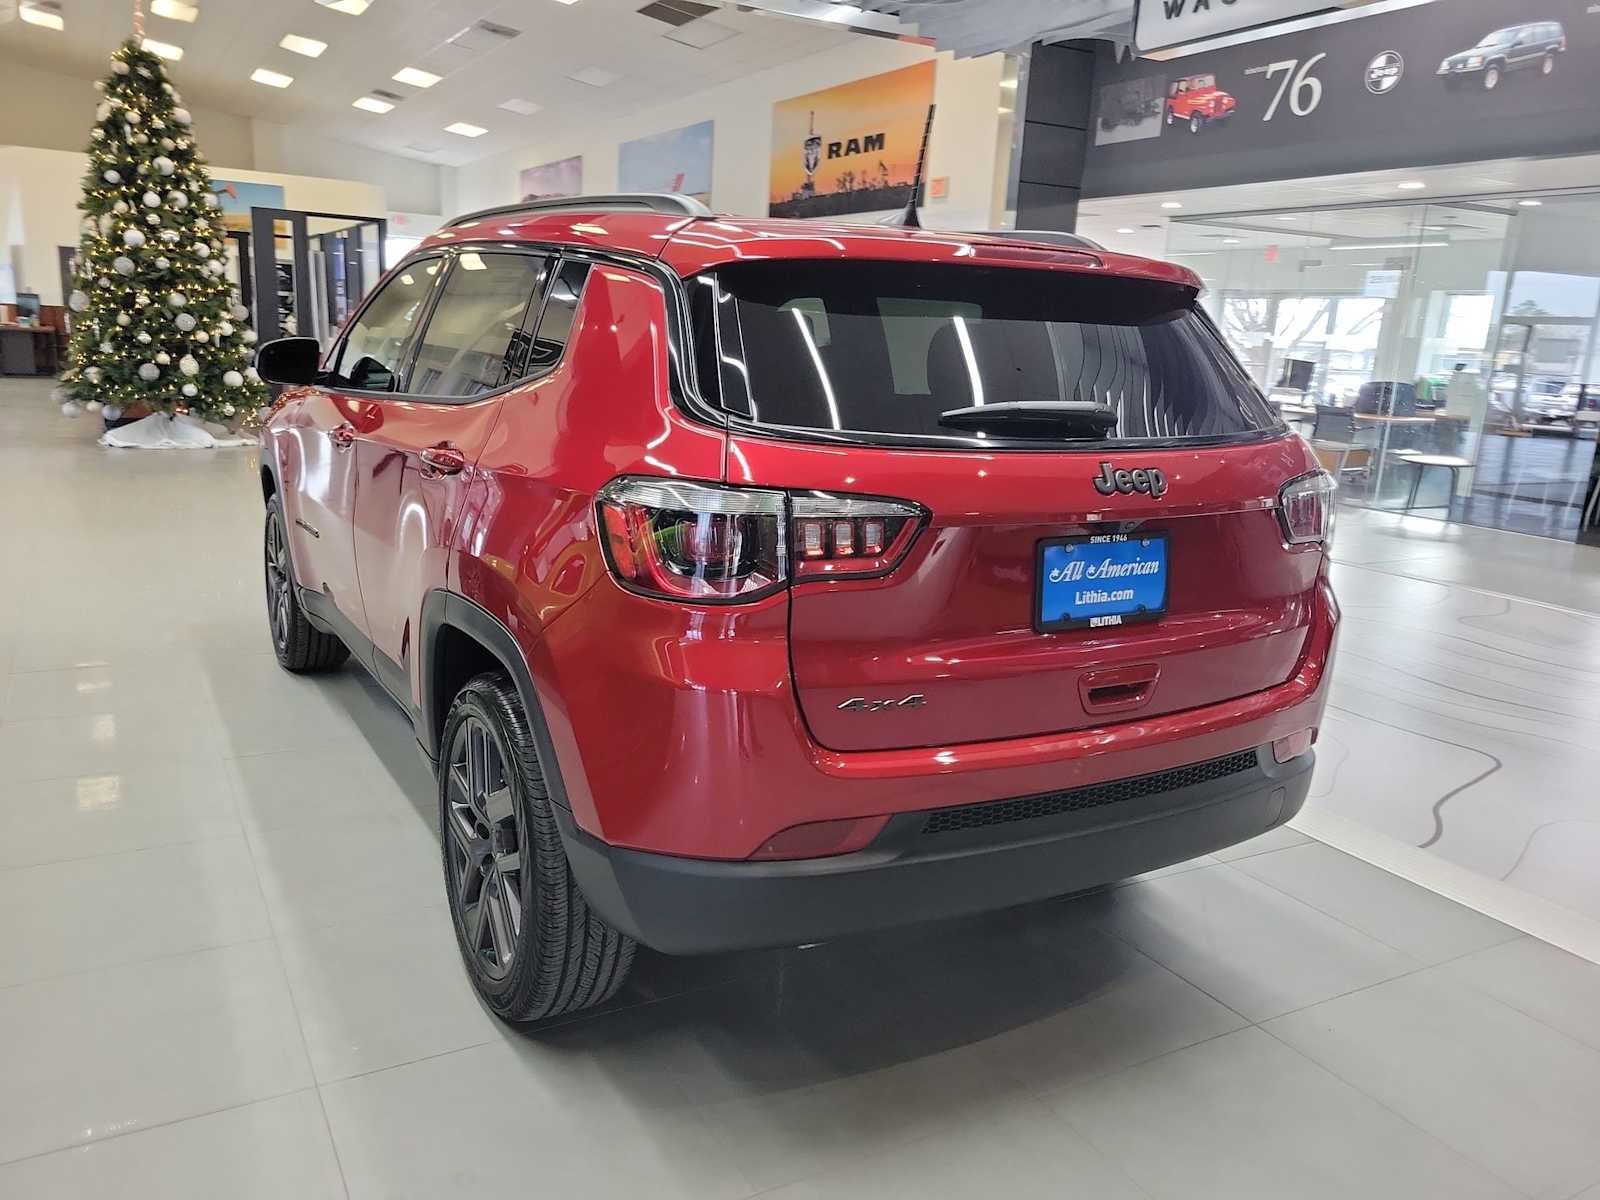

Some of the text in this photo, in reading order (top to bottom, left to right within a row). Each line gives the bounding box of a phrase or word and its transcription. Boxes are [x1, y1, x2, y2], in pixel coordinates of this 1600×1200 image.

[1163, 0, 1236, 19] WA
[1262, 52, 1327, 121] 76
[827, 133, 886, 159] RAM
[1092, 461, 1168, 500] Jeep
[1090, 534, 1128, 544] SINCE 1946
[1049, 557, 1160, 582] All American
[1075, 589, 1134, 605] Lithia.com
[838, 694, 927, 712] 4x4
